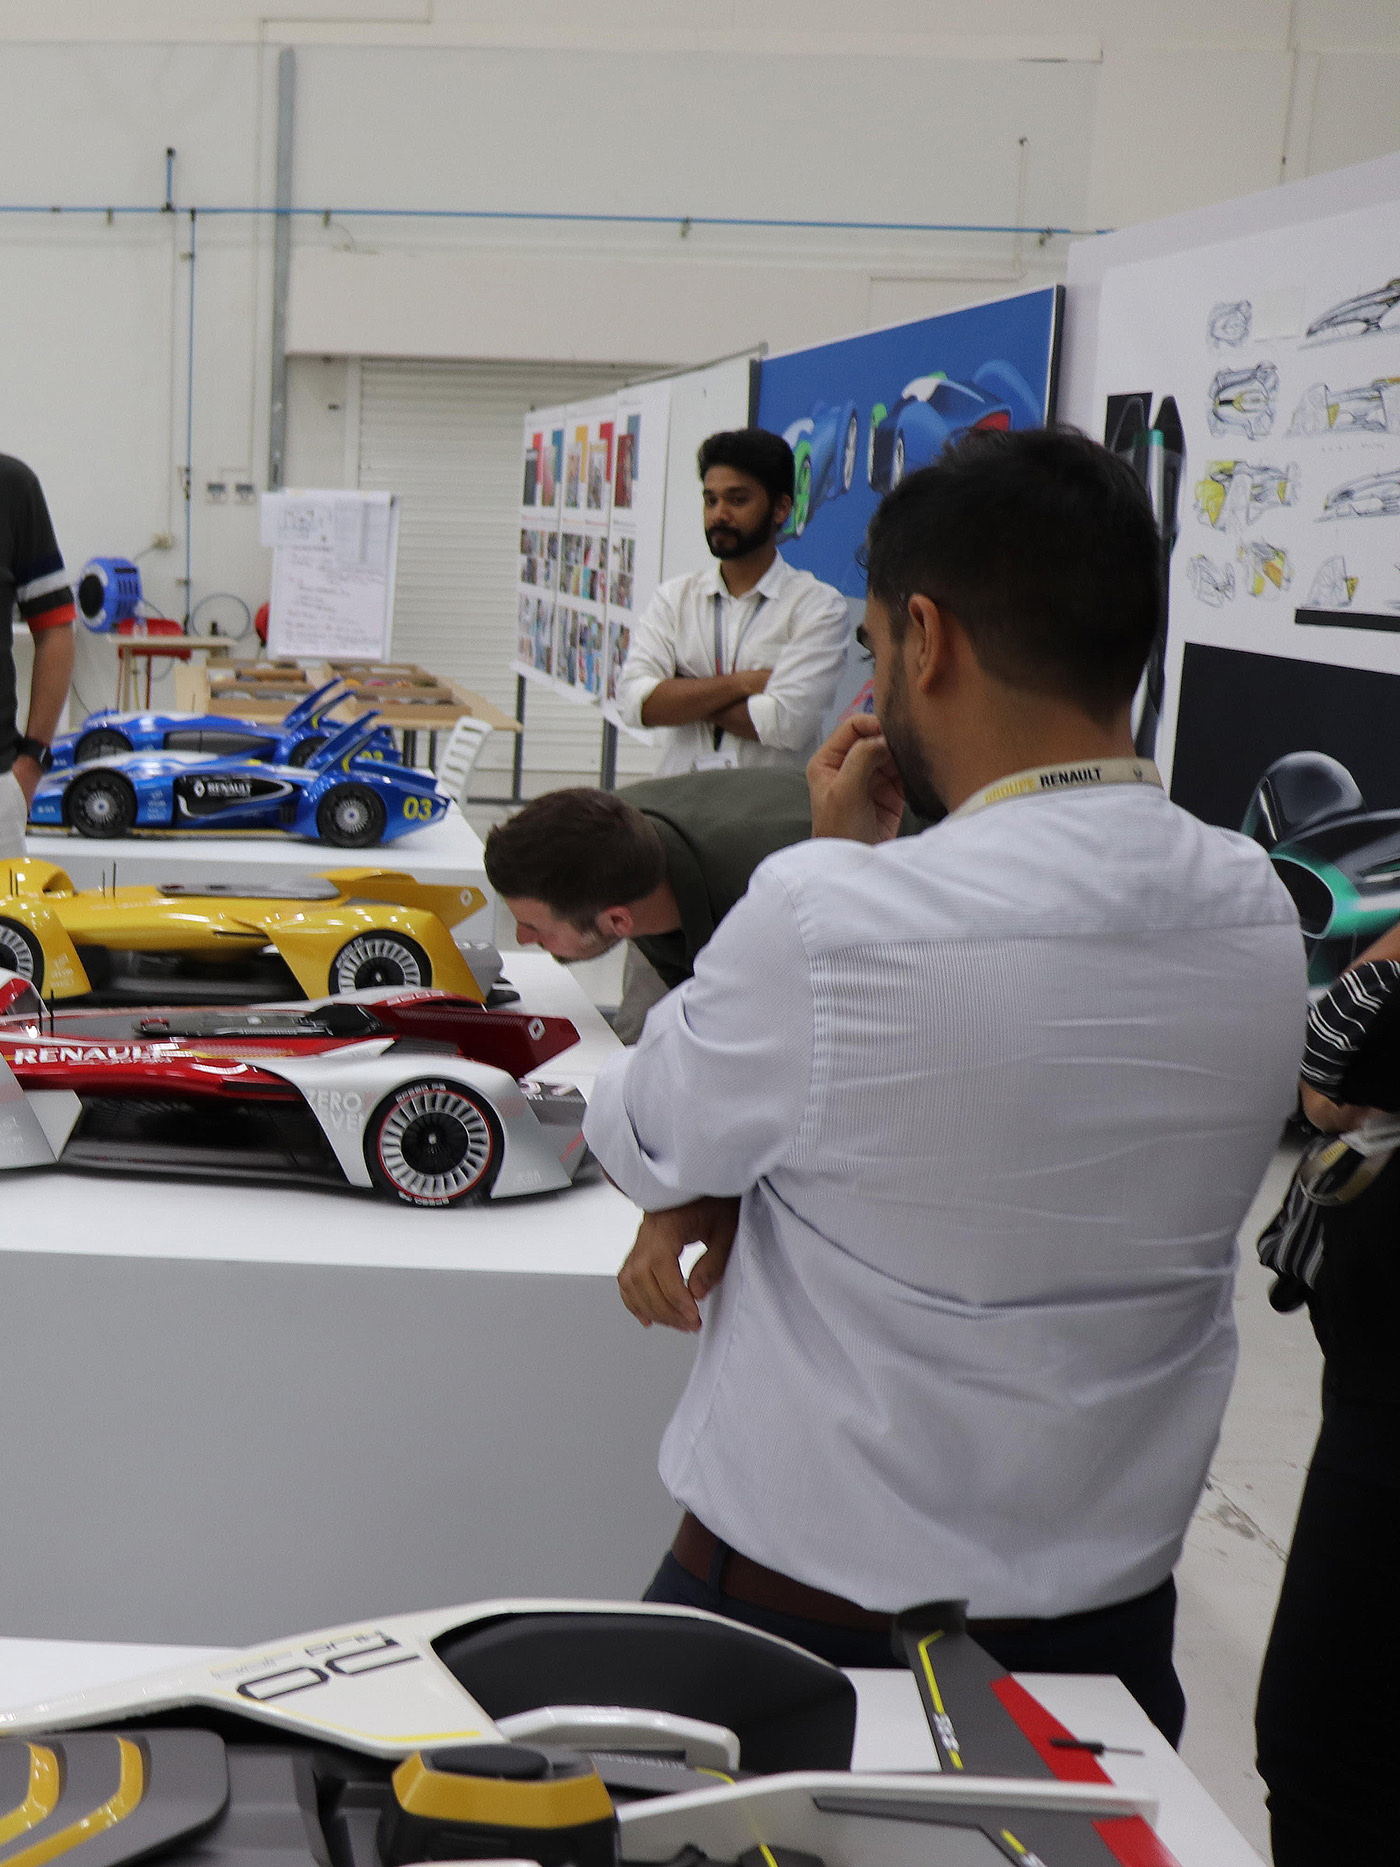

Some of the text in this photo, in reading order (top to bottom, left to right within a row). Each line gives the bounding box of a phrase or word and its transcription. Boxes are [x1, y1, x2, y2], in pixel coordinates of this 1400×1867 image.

[1039, 767, 1101, 788] RENAULT
[206, 781, 251, 796] RENAULT
[403, 796, 432, 820] 03
[14, 1046, 167, 1065] RENAULT
